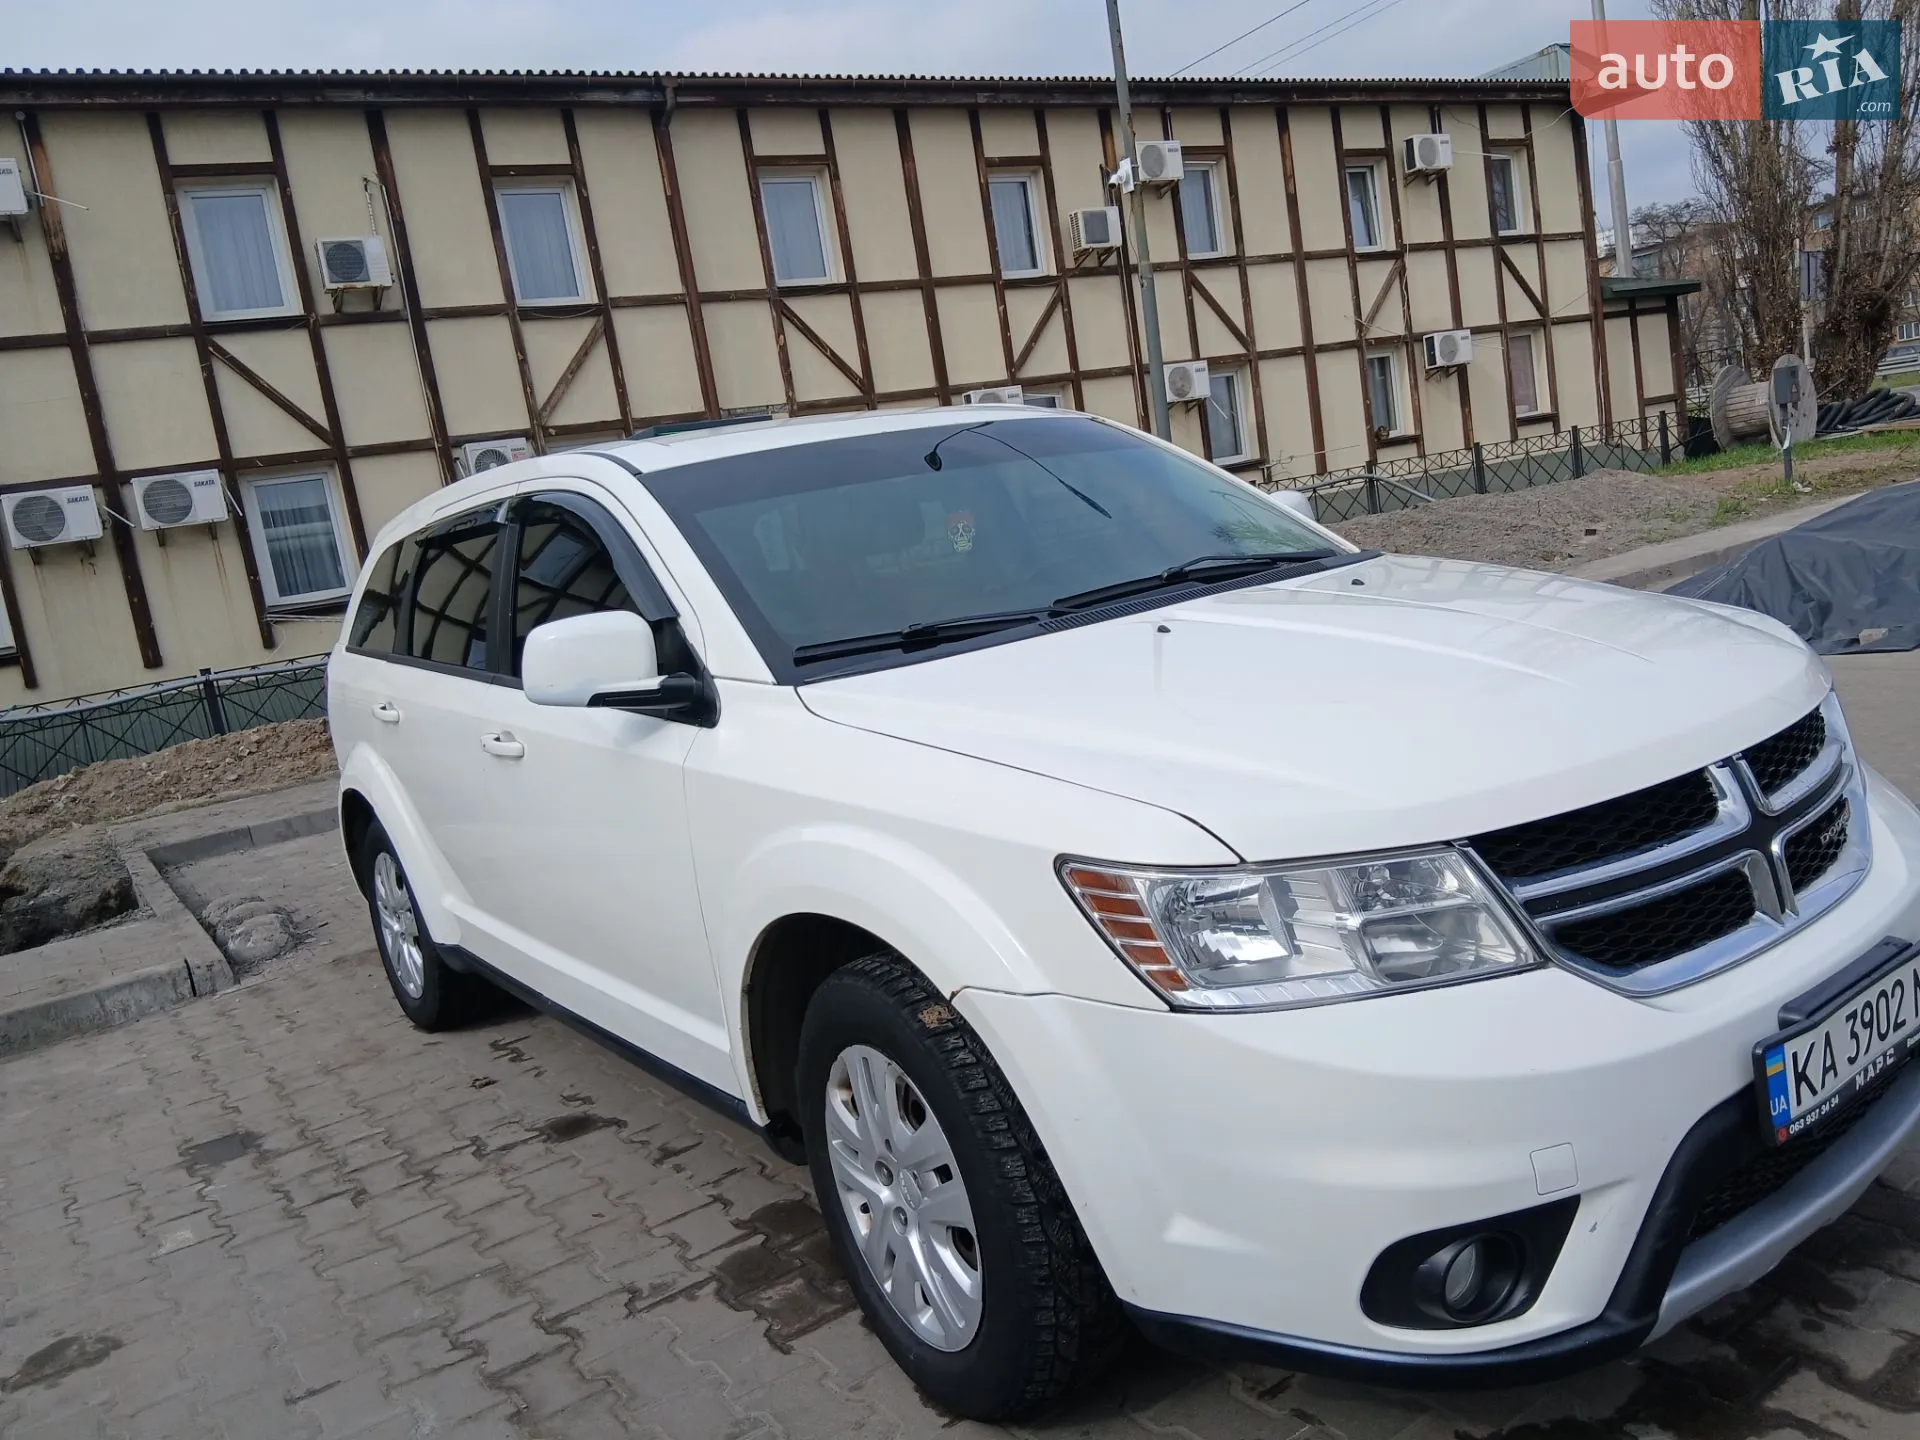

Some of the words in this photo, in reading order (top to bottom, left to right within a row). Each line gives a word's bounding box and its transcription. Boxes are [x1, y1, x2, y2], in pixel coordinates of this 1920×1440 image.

[1791, 1030, 1839, 1107] KA
[1845, 978, 1907, 1066] 3902
[1770, 1094, 1788, 1116] UA
